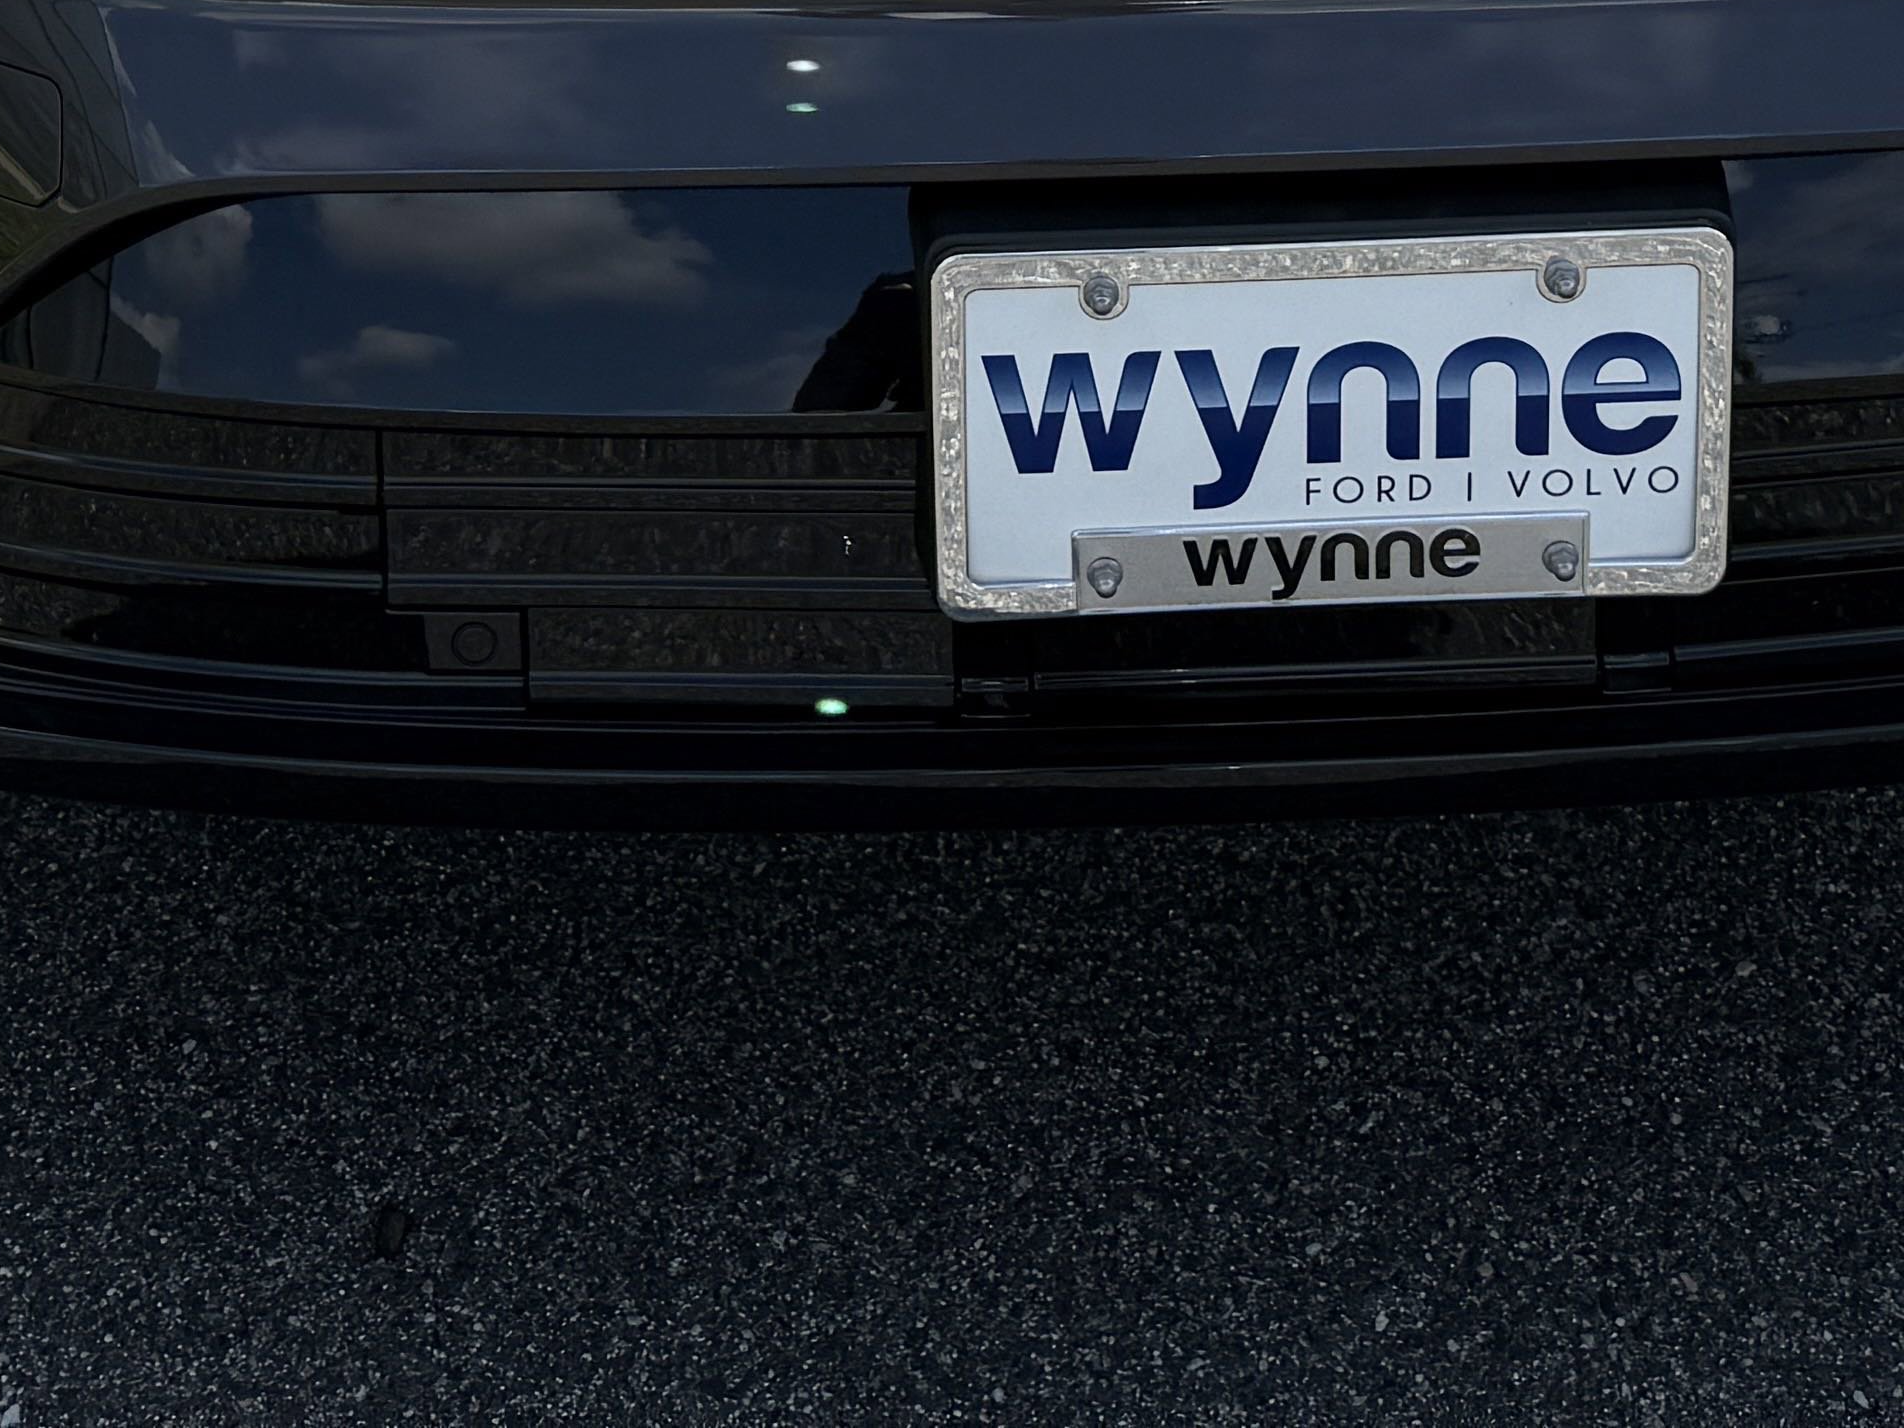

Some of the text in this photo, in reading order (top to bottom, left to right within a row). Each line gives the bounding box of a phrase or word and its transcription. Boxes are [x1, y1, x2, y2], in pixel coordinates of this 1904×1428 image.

[980, 331, 1683, 511] wynne
[1305, 473, 1432, 506] FORD
[1506, 465, 1680, 499] VOLVO
[1181, 527, 1482, 601] wynne
